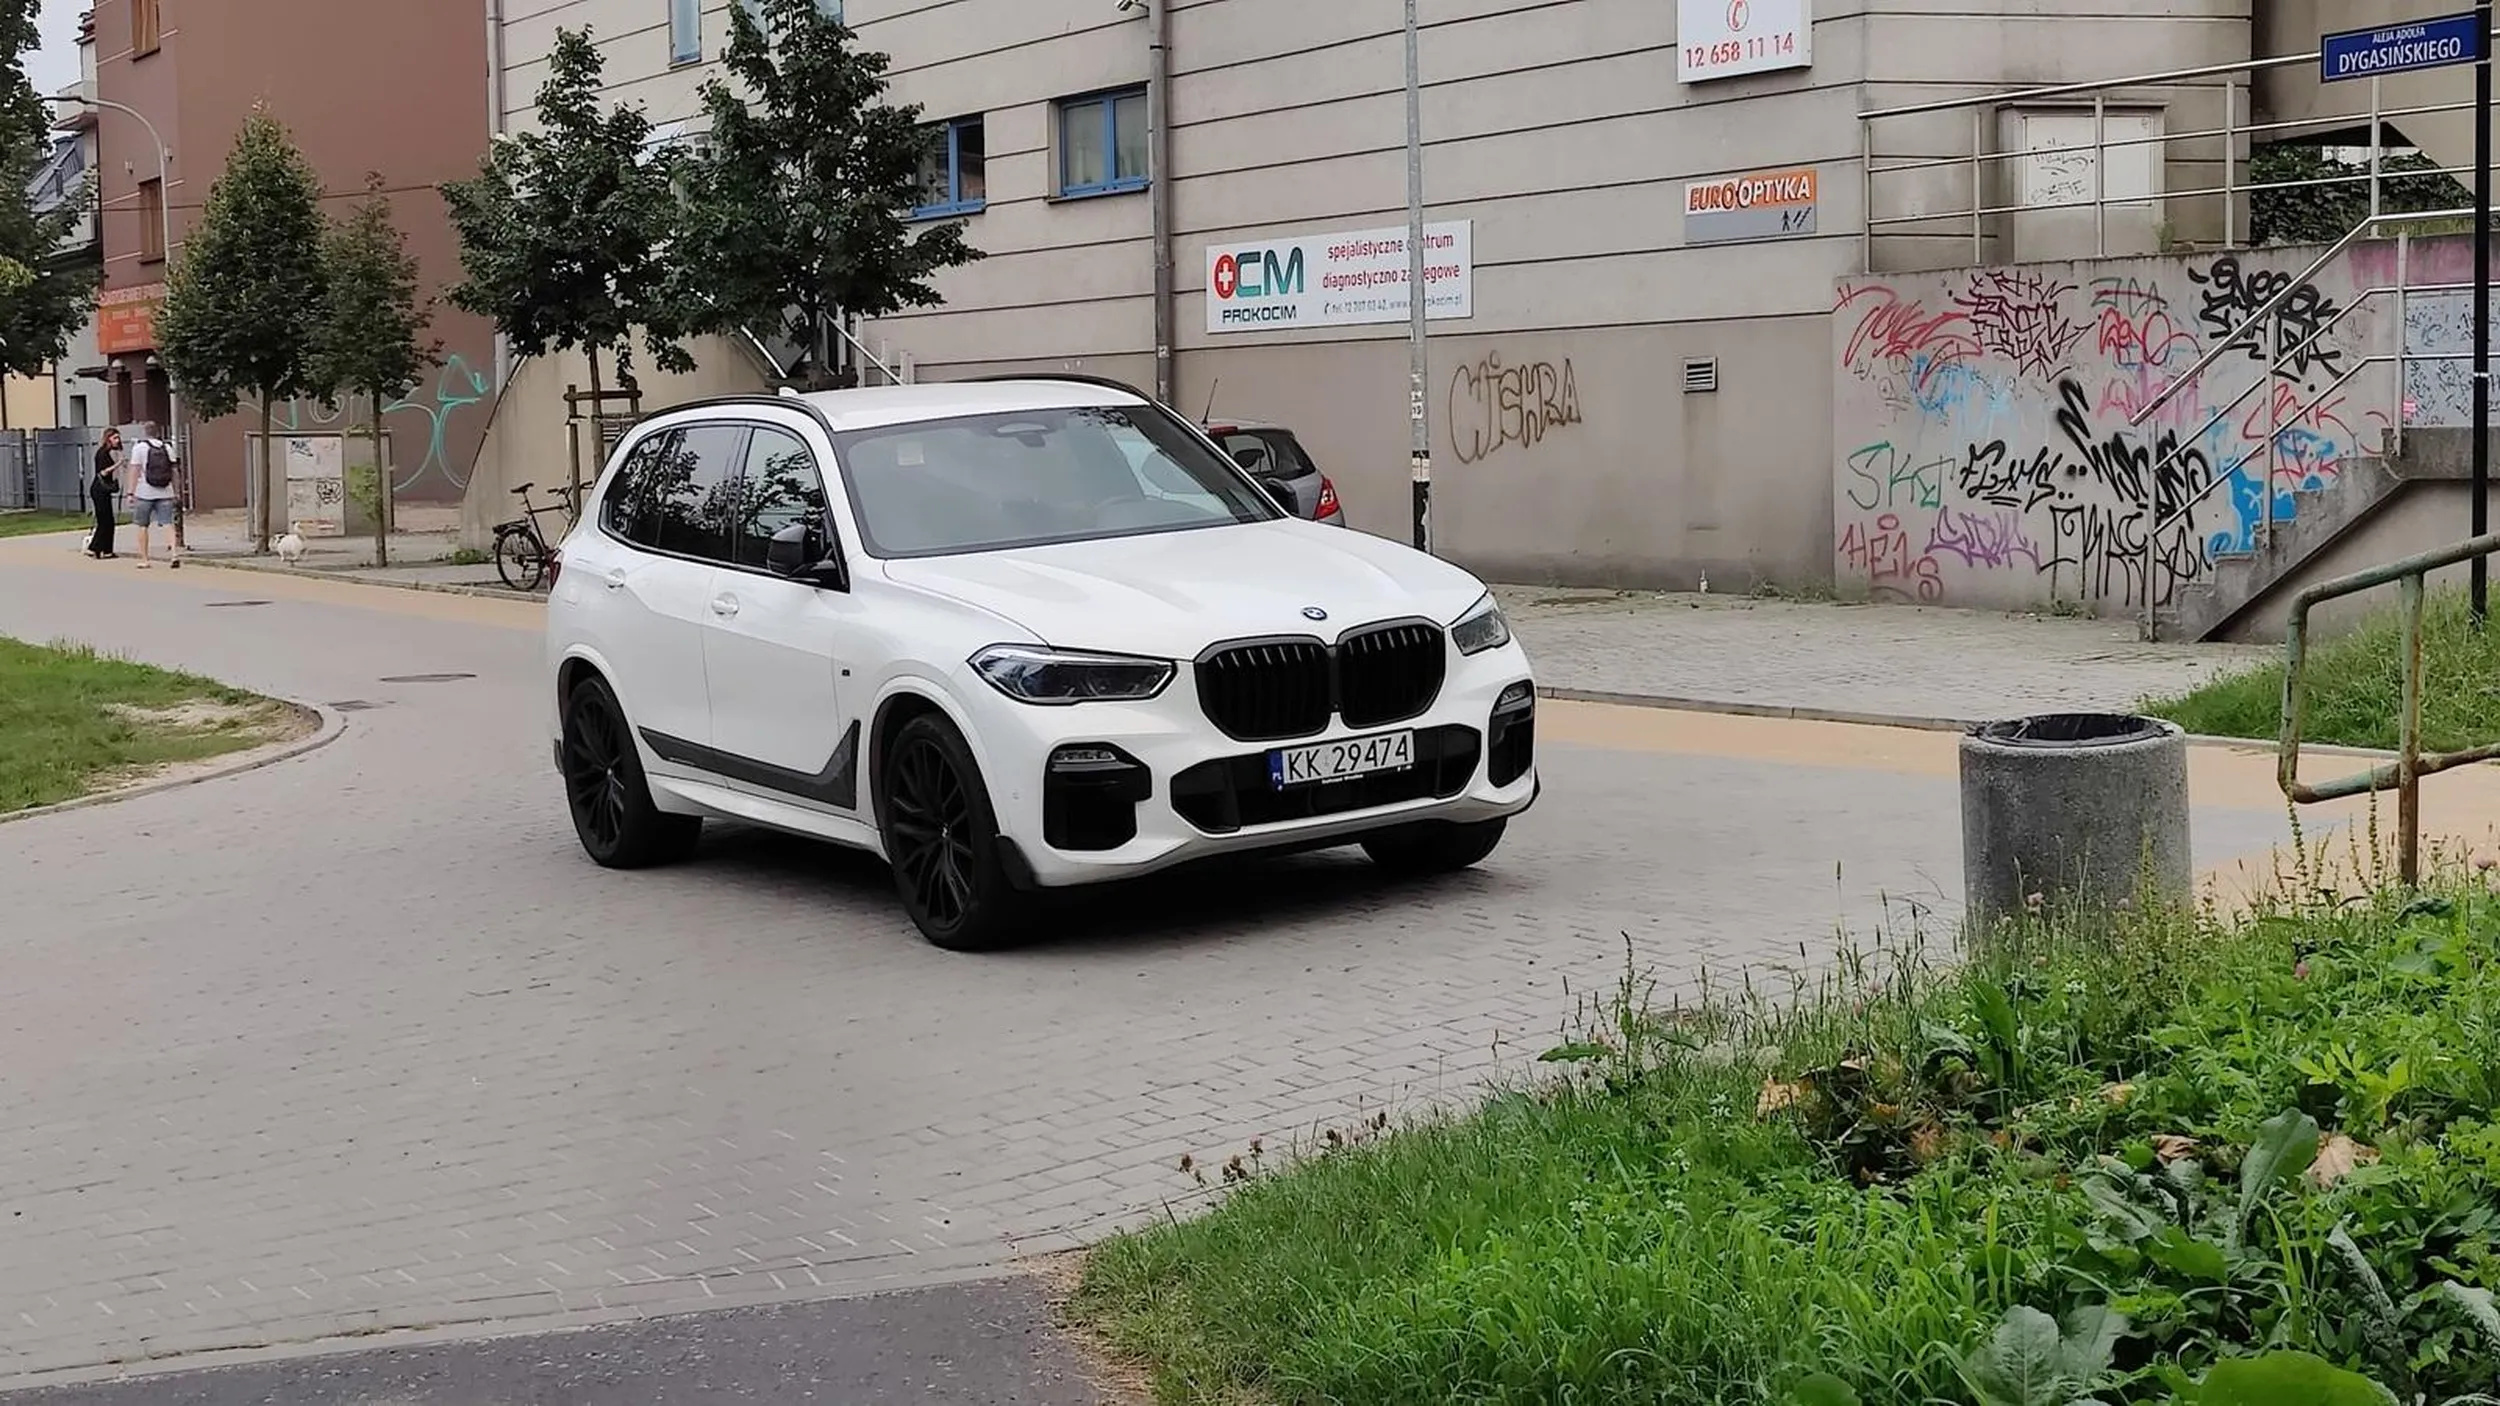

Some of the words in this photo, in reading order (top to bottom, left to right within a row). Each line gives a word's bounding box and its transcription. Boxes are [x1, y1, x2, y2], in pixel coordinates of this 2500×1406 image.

[2372, 31, 2395, 44] ALEJA
[1686, 47, 1705, 68] 12
[1710, 41, 1740, 64] 658
[1747, 37, 1764, 59] 11
[1774, 32, 1794, 55] 14
[2339, 37, 2461, 73] DYGASIŃSKIEGO
[1327, 239, 1403, 262] spejalistyczne
[1322, 270, 1398, 291] diagnostyczno
[1222, 304, 1297, 324] PROKOCIM
[1287, 751, 1322, 781] KK
[1331, 734, 1409, 774] 29474
